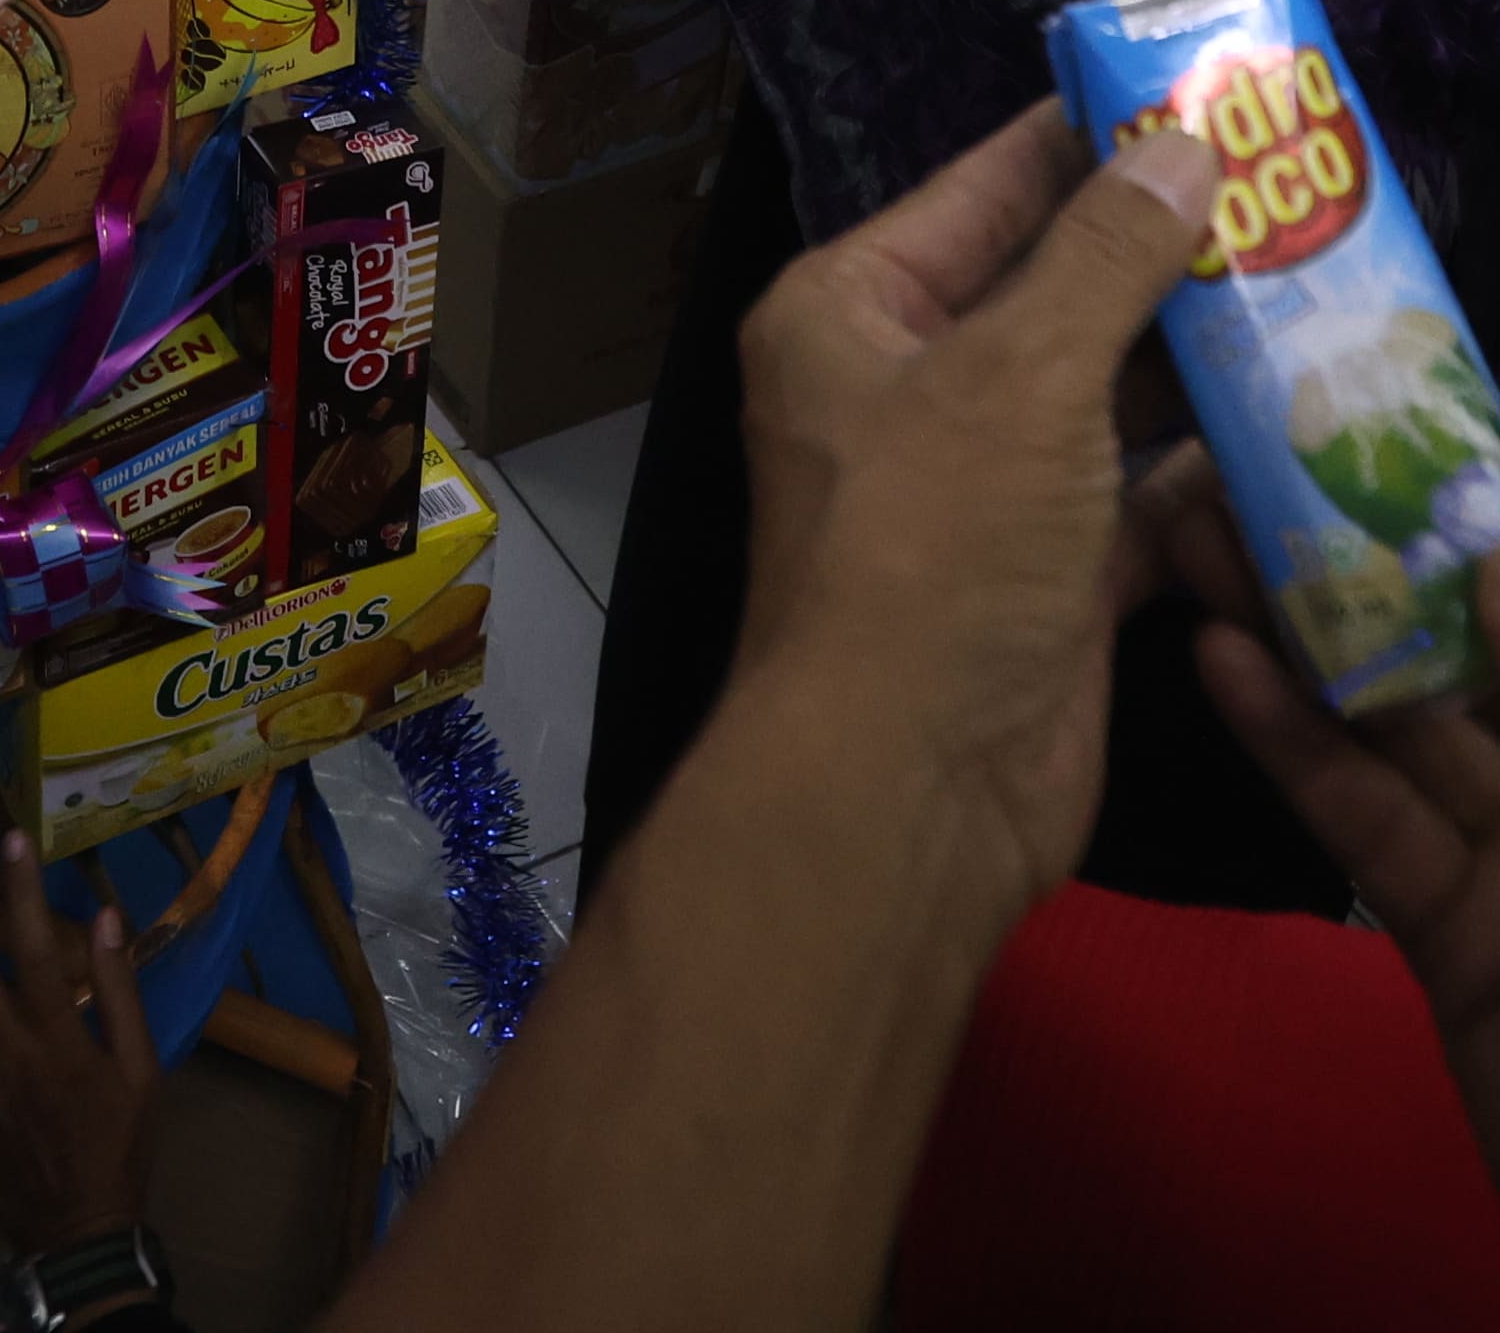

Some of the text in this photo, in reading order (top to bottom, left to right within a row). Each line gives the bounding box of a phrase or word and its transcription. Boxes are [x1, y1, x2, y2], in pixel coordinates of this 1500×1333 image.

[344, 128, 420, 154] Tango
[305, 253, 331, 331] Chocolate
[324, 200, 412, 392] Tango
[329, 258, 349, 307] Royal
[101, 403, 259, 493] BIH BANYAK SEREAL
[109, 440, 244, 519] ERGEN
[155, 595, 391, 720] Custas
